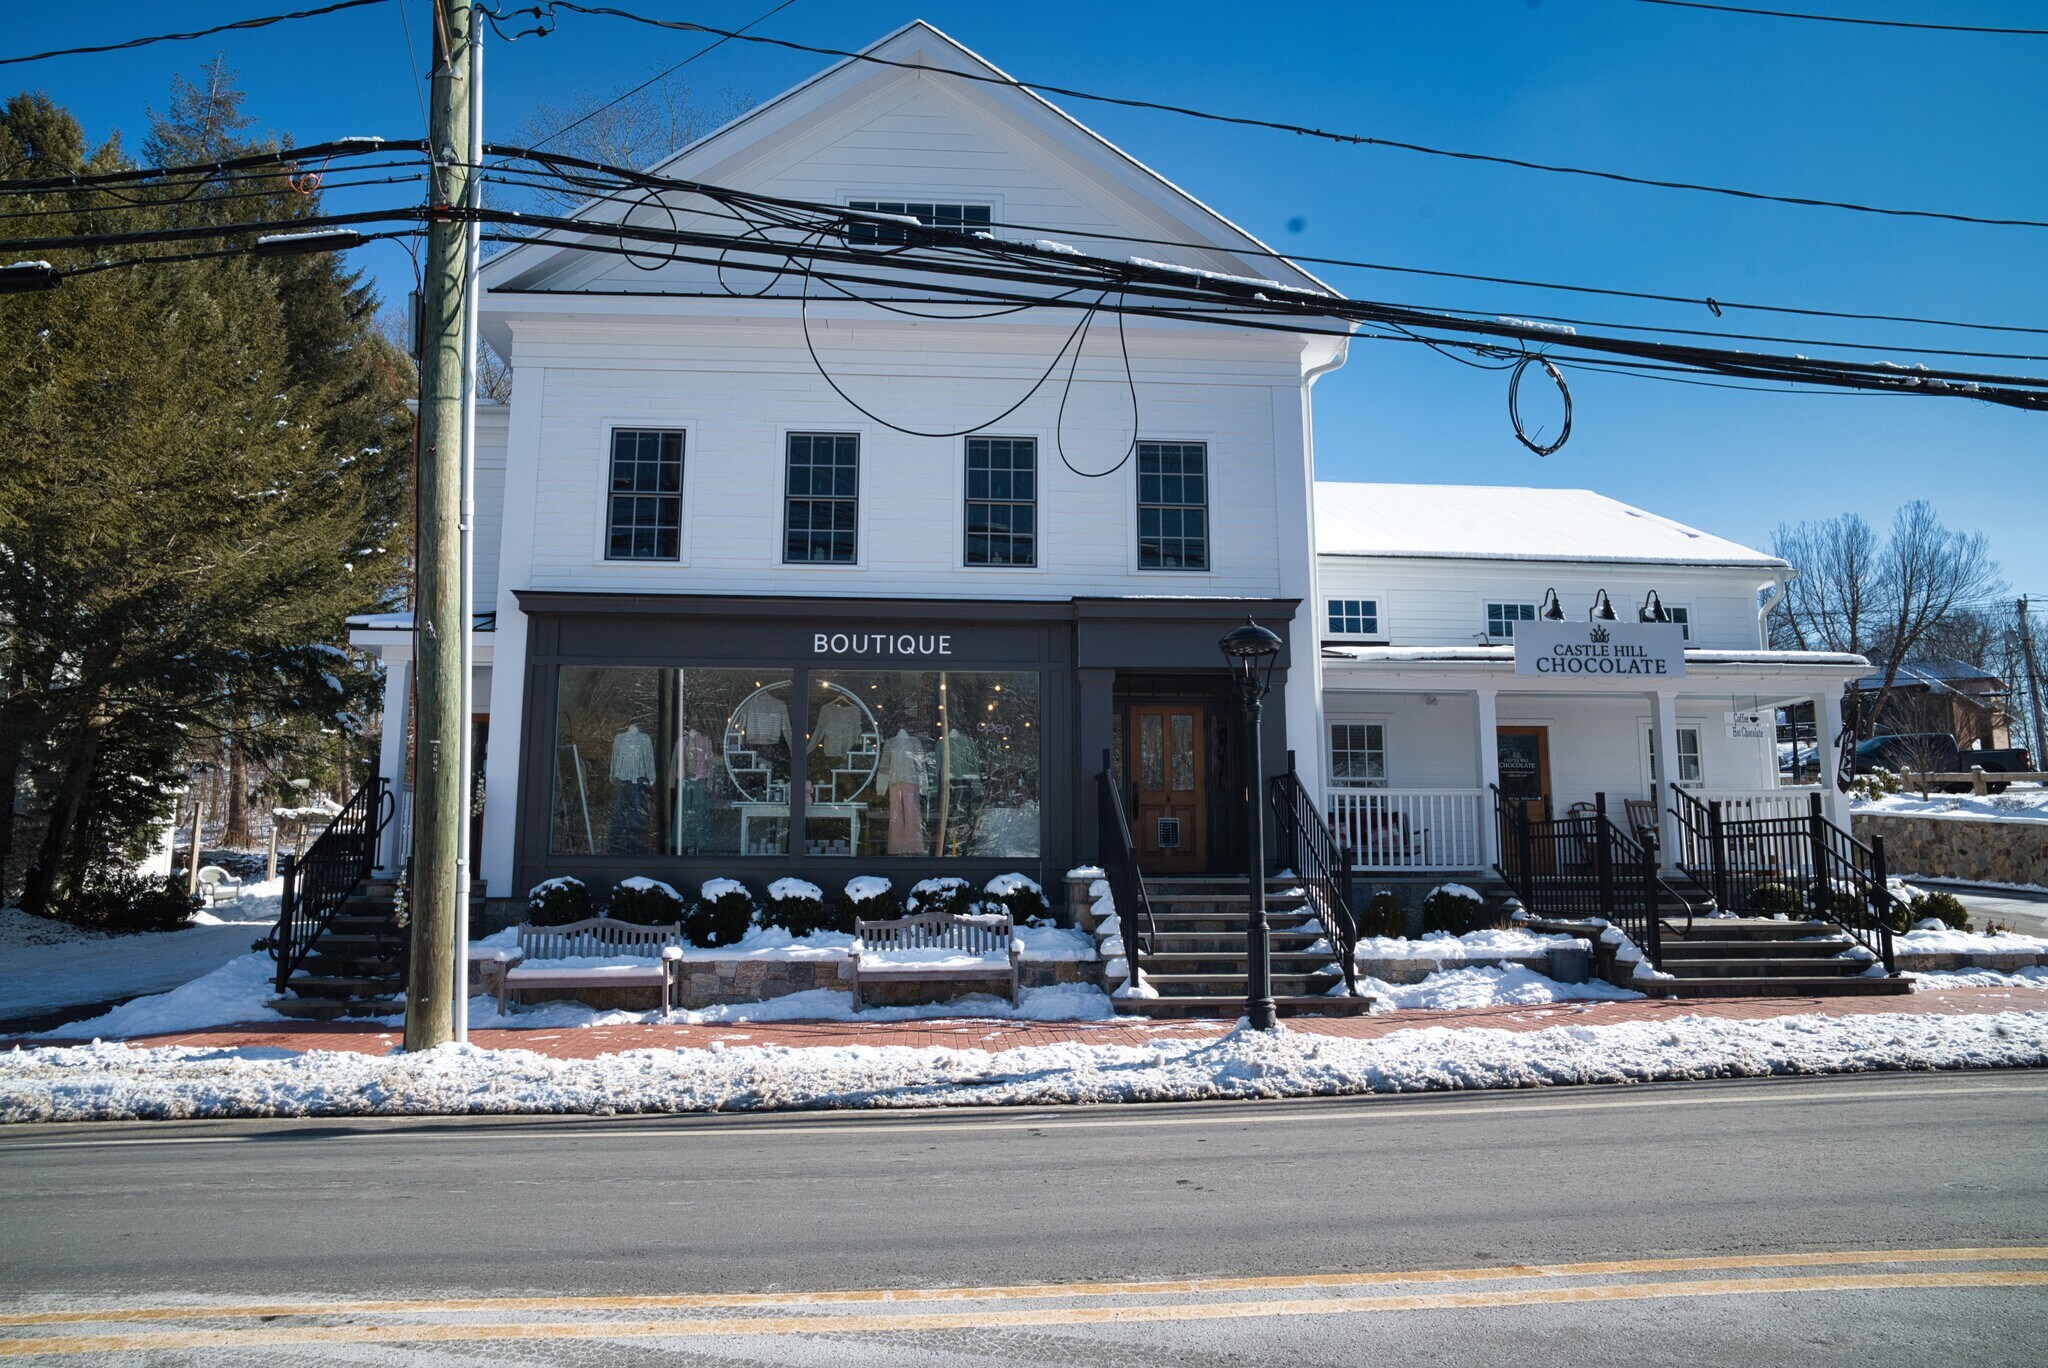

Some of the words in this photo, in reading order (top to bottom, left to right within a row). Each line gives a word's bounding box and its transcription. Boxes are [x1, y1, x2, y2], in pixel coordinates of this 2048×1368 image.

[813, 633, 952, 655] BOUTIQUE
[1553, 644, 1610, 657] CASTLE
[1614, 645, 1648, 657] HILL
[1536, 657, 1667, 674] CHOCOLATE
[1733, 712, 1749, 723] Coffee
[1732, 727, 1741, 737] Hot
[1742, 727, 1763, 738] Chocolate
